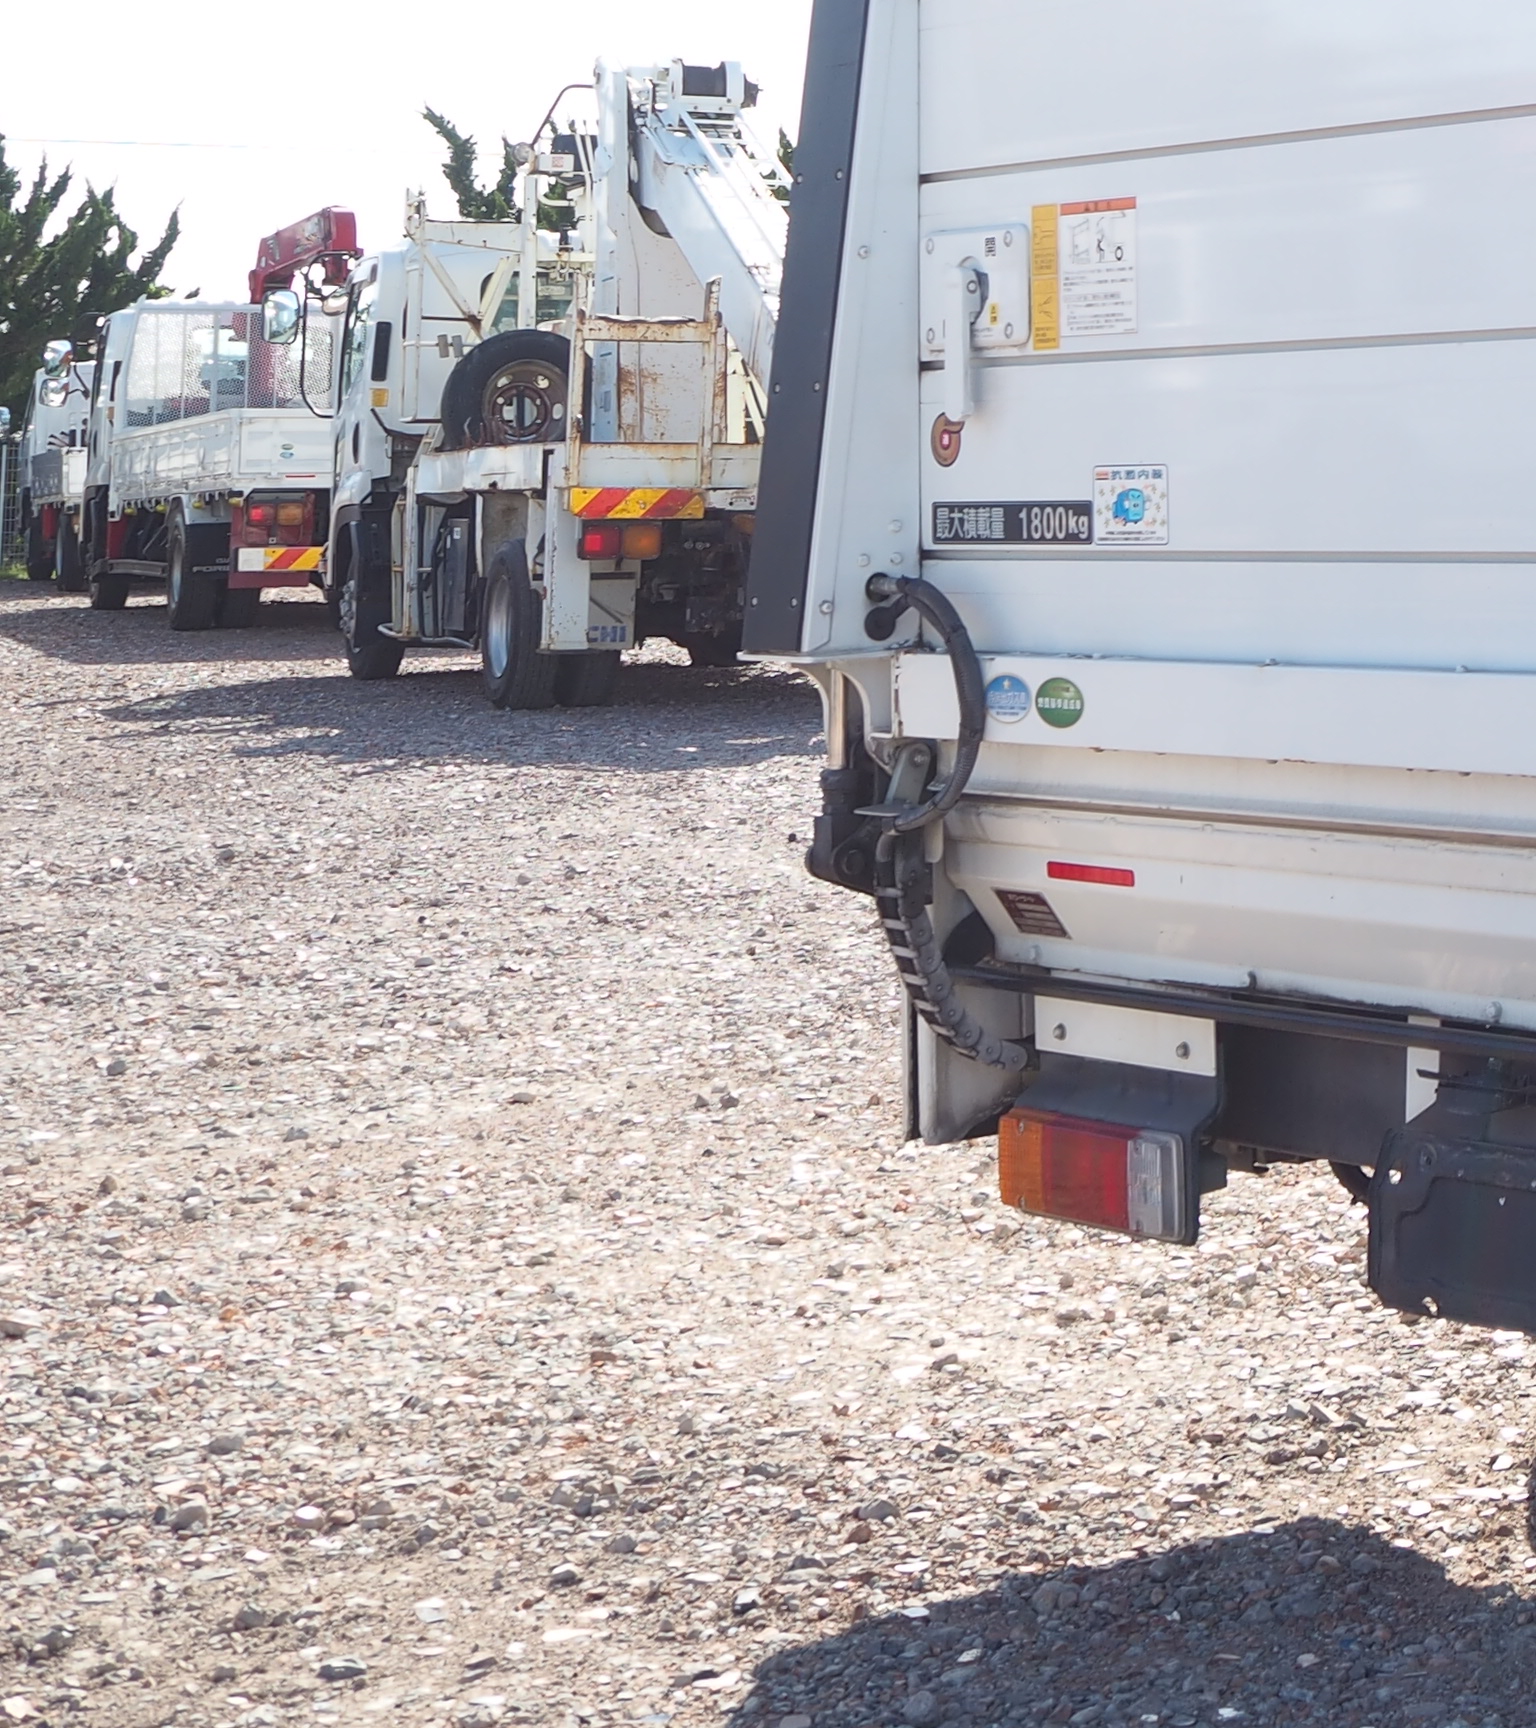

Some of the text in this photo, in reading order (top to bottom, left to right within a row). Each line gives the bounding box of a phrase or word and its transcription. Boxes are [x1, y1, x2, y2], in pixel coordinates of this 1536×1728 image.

[935, 506, 1005, 540] 最大積載量
